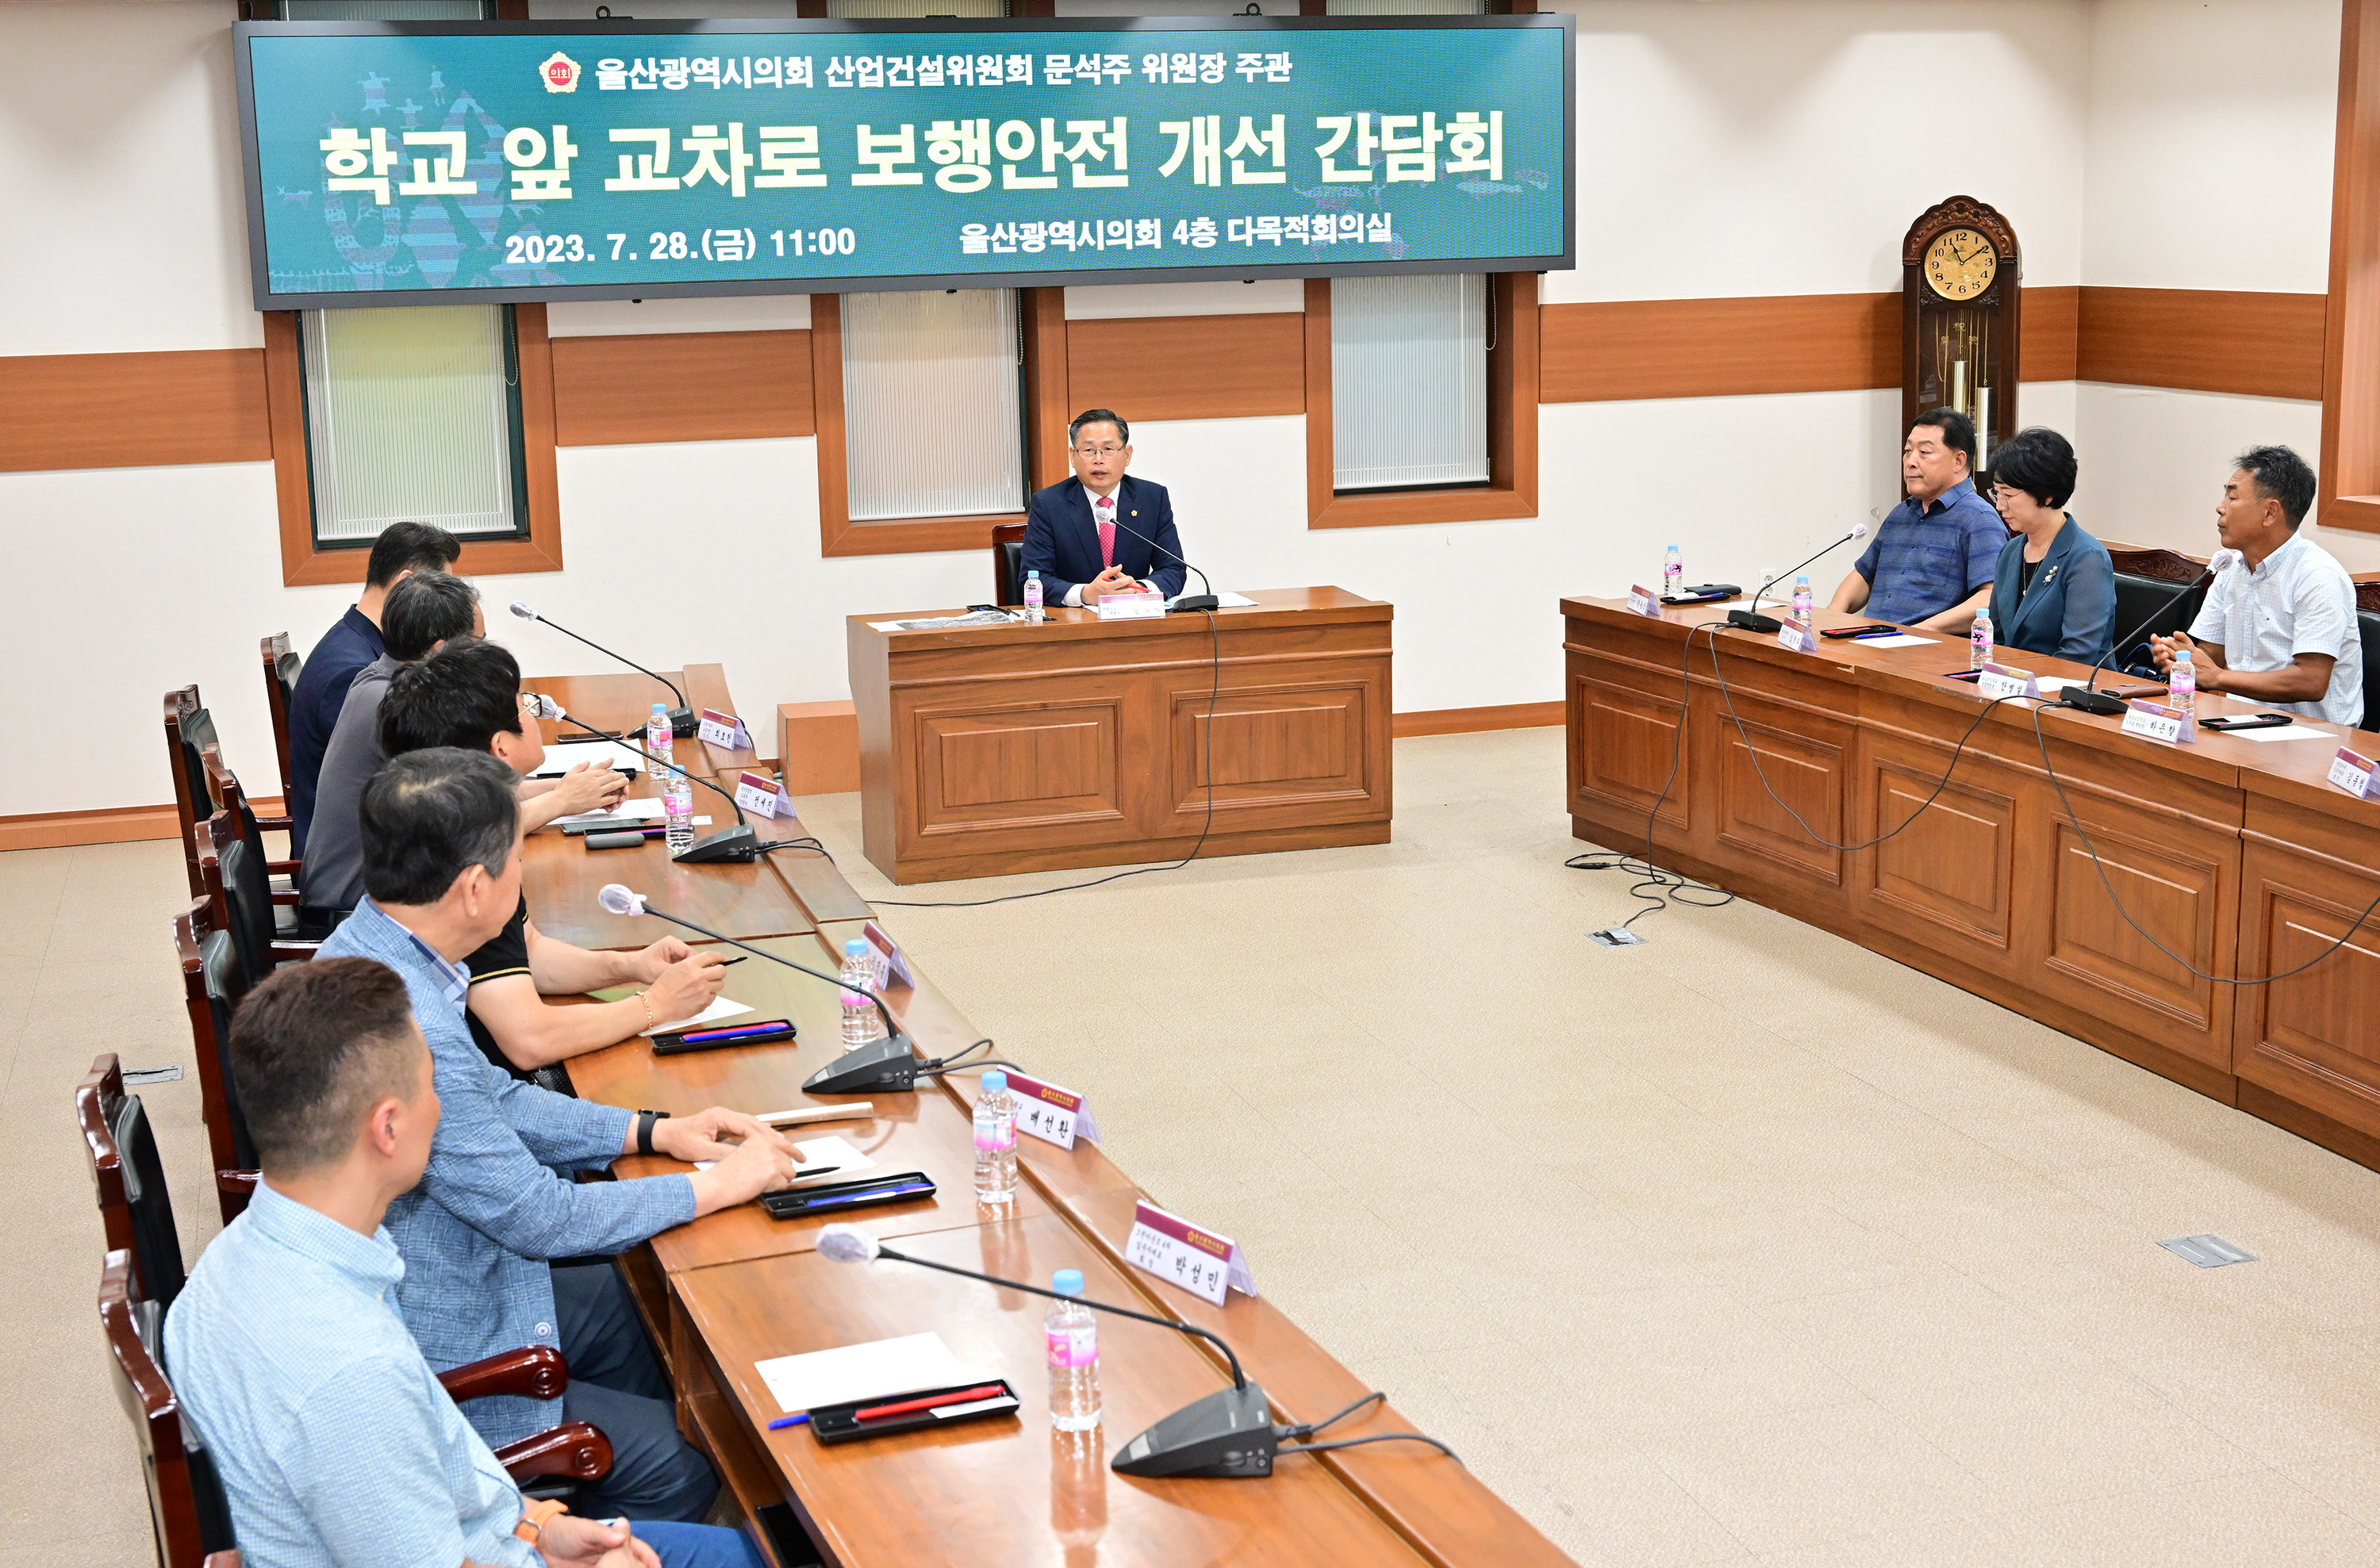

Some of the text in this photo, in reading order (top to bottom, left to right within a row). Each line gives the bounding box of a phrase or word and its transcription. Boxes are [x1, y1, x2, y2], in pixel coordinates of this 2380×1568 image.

[550, 67, 571, 79] 의회
[595, 52, 1292, 90] 울산광역시의회 산업건설위원회 문석주 위원장 주관
[320, 111, 1503, 205] 학교 앞 교차로 보행안전 개선 간담회
[960, 213, 1392, 253] 울산광역시의회 4층 다목적회의실
[1956, 232, 1967, 241] 12
[1944, 237, 1952, 246] 11
[1975, 236, 1979, 244] 1
[506, 228, 855, 263] 2023. 7. 28.(금) 11:00
[1935, 248, 1944, 257] 10
[1932, 261, 1940, 270] 9
[1985, 258, 1993, 266] 3
[1944, 282, 1953, 290] 7
[1972, 281, 1980, 290] 5
